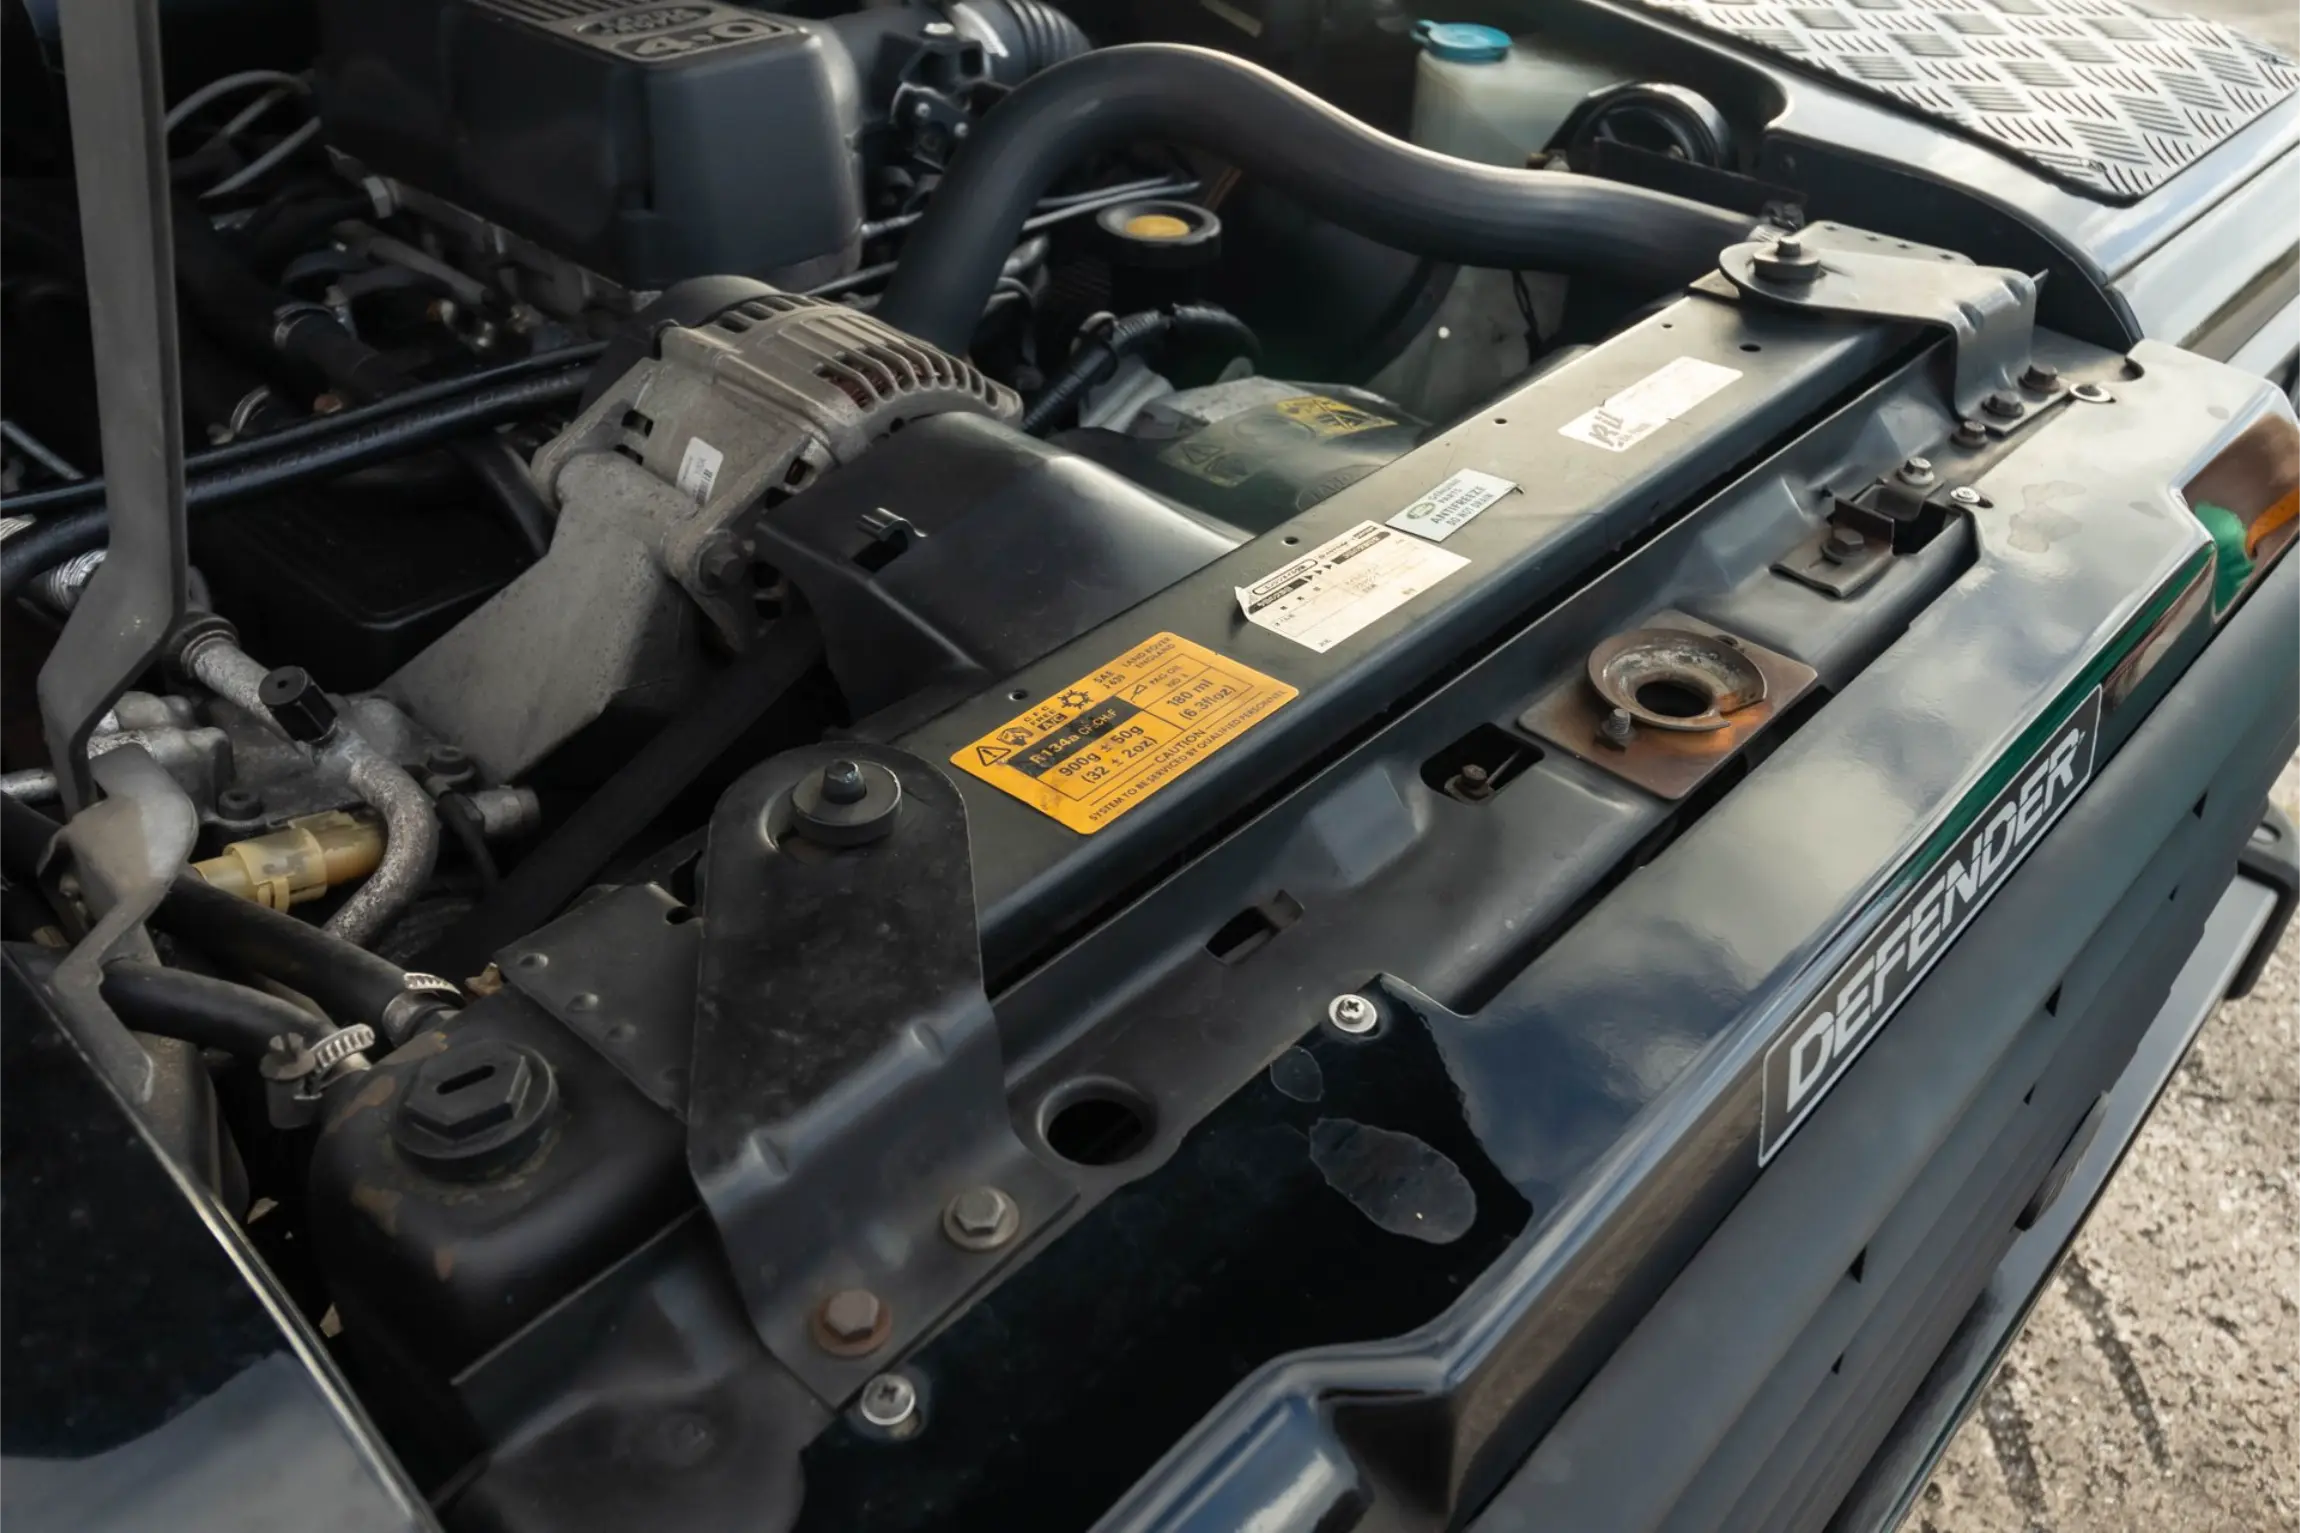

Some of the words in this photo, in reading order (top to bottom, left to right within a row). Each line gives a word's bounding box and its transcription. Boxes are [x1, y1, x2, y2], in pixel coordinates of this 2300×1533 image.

[1429, 485, 1487, 524] ANTIFREEZE
[1166, 691, 1193, 706] 180
[1192, 678, 1213, 692] ml
[1029, 709, 1058, 726] FREE
[1029, 734, 1080, 764] R134a
[1057, 752, 1101, 776] 900g
[1109, 725, 1144, 744] 50g
[1080, 766, 1110, 784] (32
[1120, 735, 1158, 758] 2oz)
[1153, 728, 1206, 763] CAUTION
[1088, 797, 1124, 820] SYSTEM
[1121, 787, 1137, 797] TO
[1135, 781, 1149, 789] BE
[1146, 755, 1187, 782] SERVICED
[1185, 747, 1198, 756] BY
[1196, 718, 1241, 748] QUALIFIED
[1787, 728, 2085, 1113] DEFENDER
